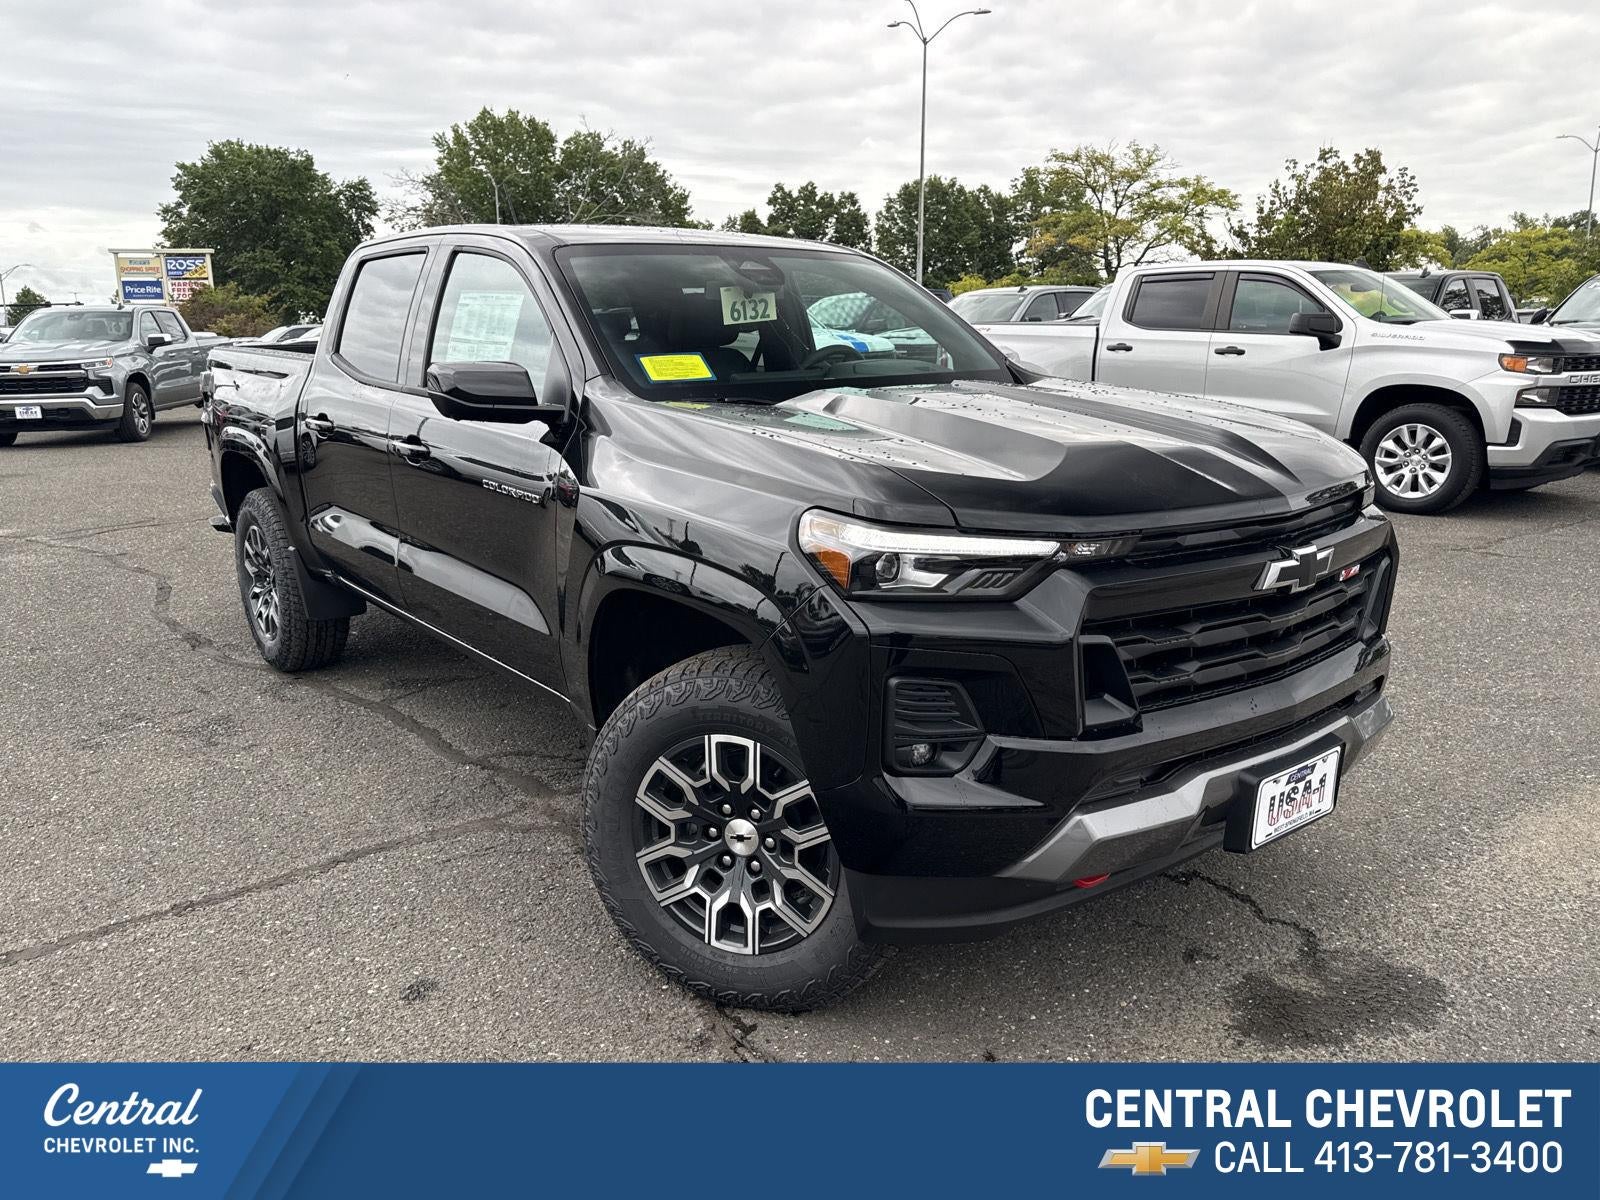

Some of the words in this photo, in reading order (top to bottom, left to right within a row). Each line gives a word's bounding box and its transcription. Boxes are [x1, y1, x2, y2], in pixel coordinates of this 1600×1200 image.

[167, 259, 204, 270] ROSS
[125, 285, 146, 294] Price
[146, 285, 162, 294] Rite
[729, 298, 771, 322] 6132
[482, 479, 542, 504] COLORADO
[696, 711, 775, 733] TERRITORY
[1290, 767, 1312, 782] CENTRAL
[1267, 773, 1327, 827] USA-1
